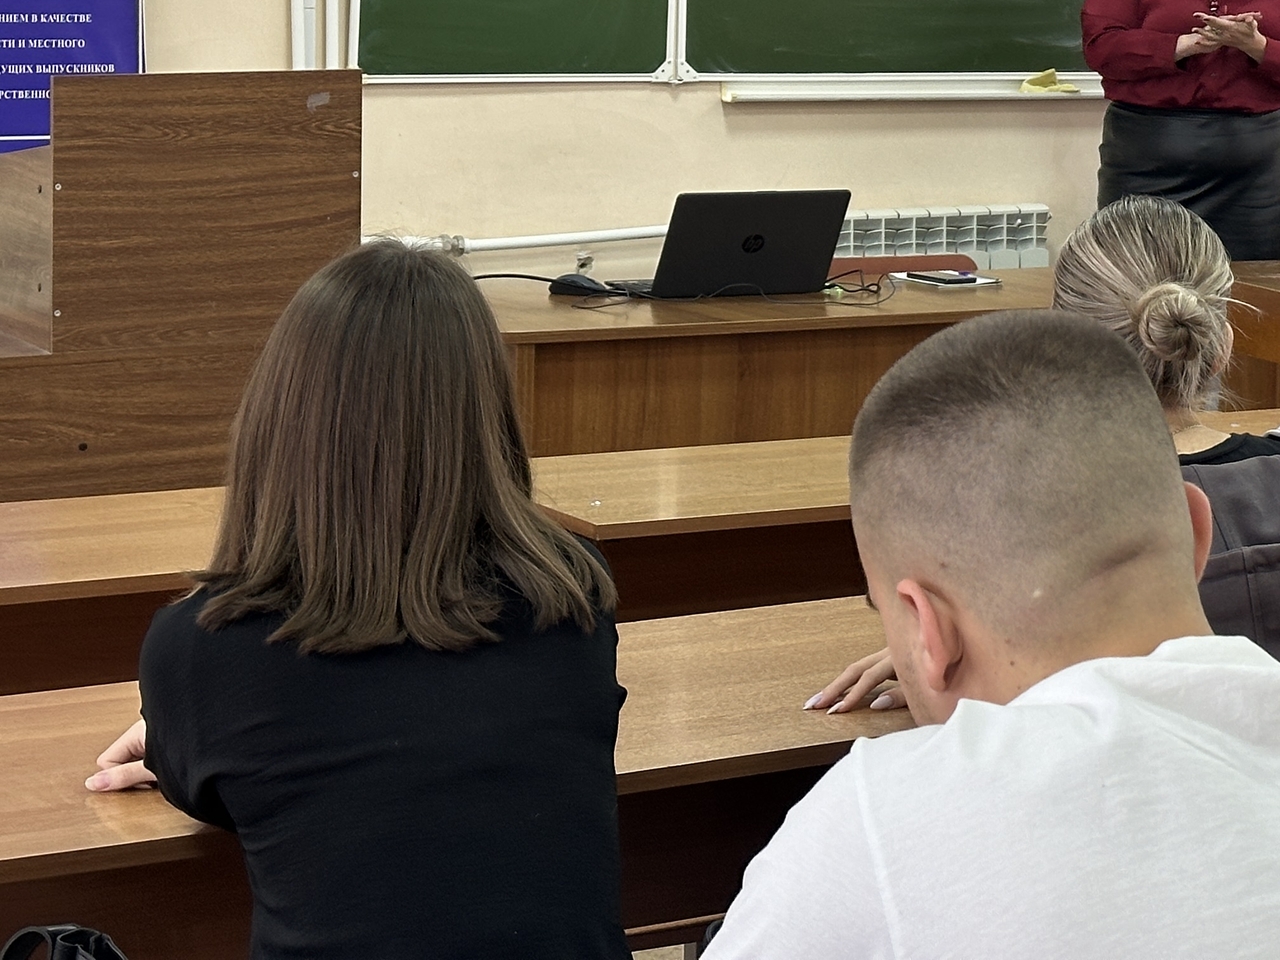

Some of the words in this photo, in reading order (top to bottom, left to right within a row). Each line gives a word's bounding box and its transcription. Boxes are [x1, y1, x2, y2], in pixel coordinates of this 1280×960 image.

[31, 14, 38, 23] В
[40, 14, 92, 23] КАЧЕСТВЕ
[18, 40, 26, 49] И
[28, 39, 86, 49] МЕСТНОГО
[0, 65, 34, 75] УЩИХ
[35, 64, 115, 74] ВЫПУСКНИКОВ
